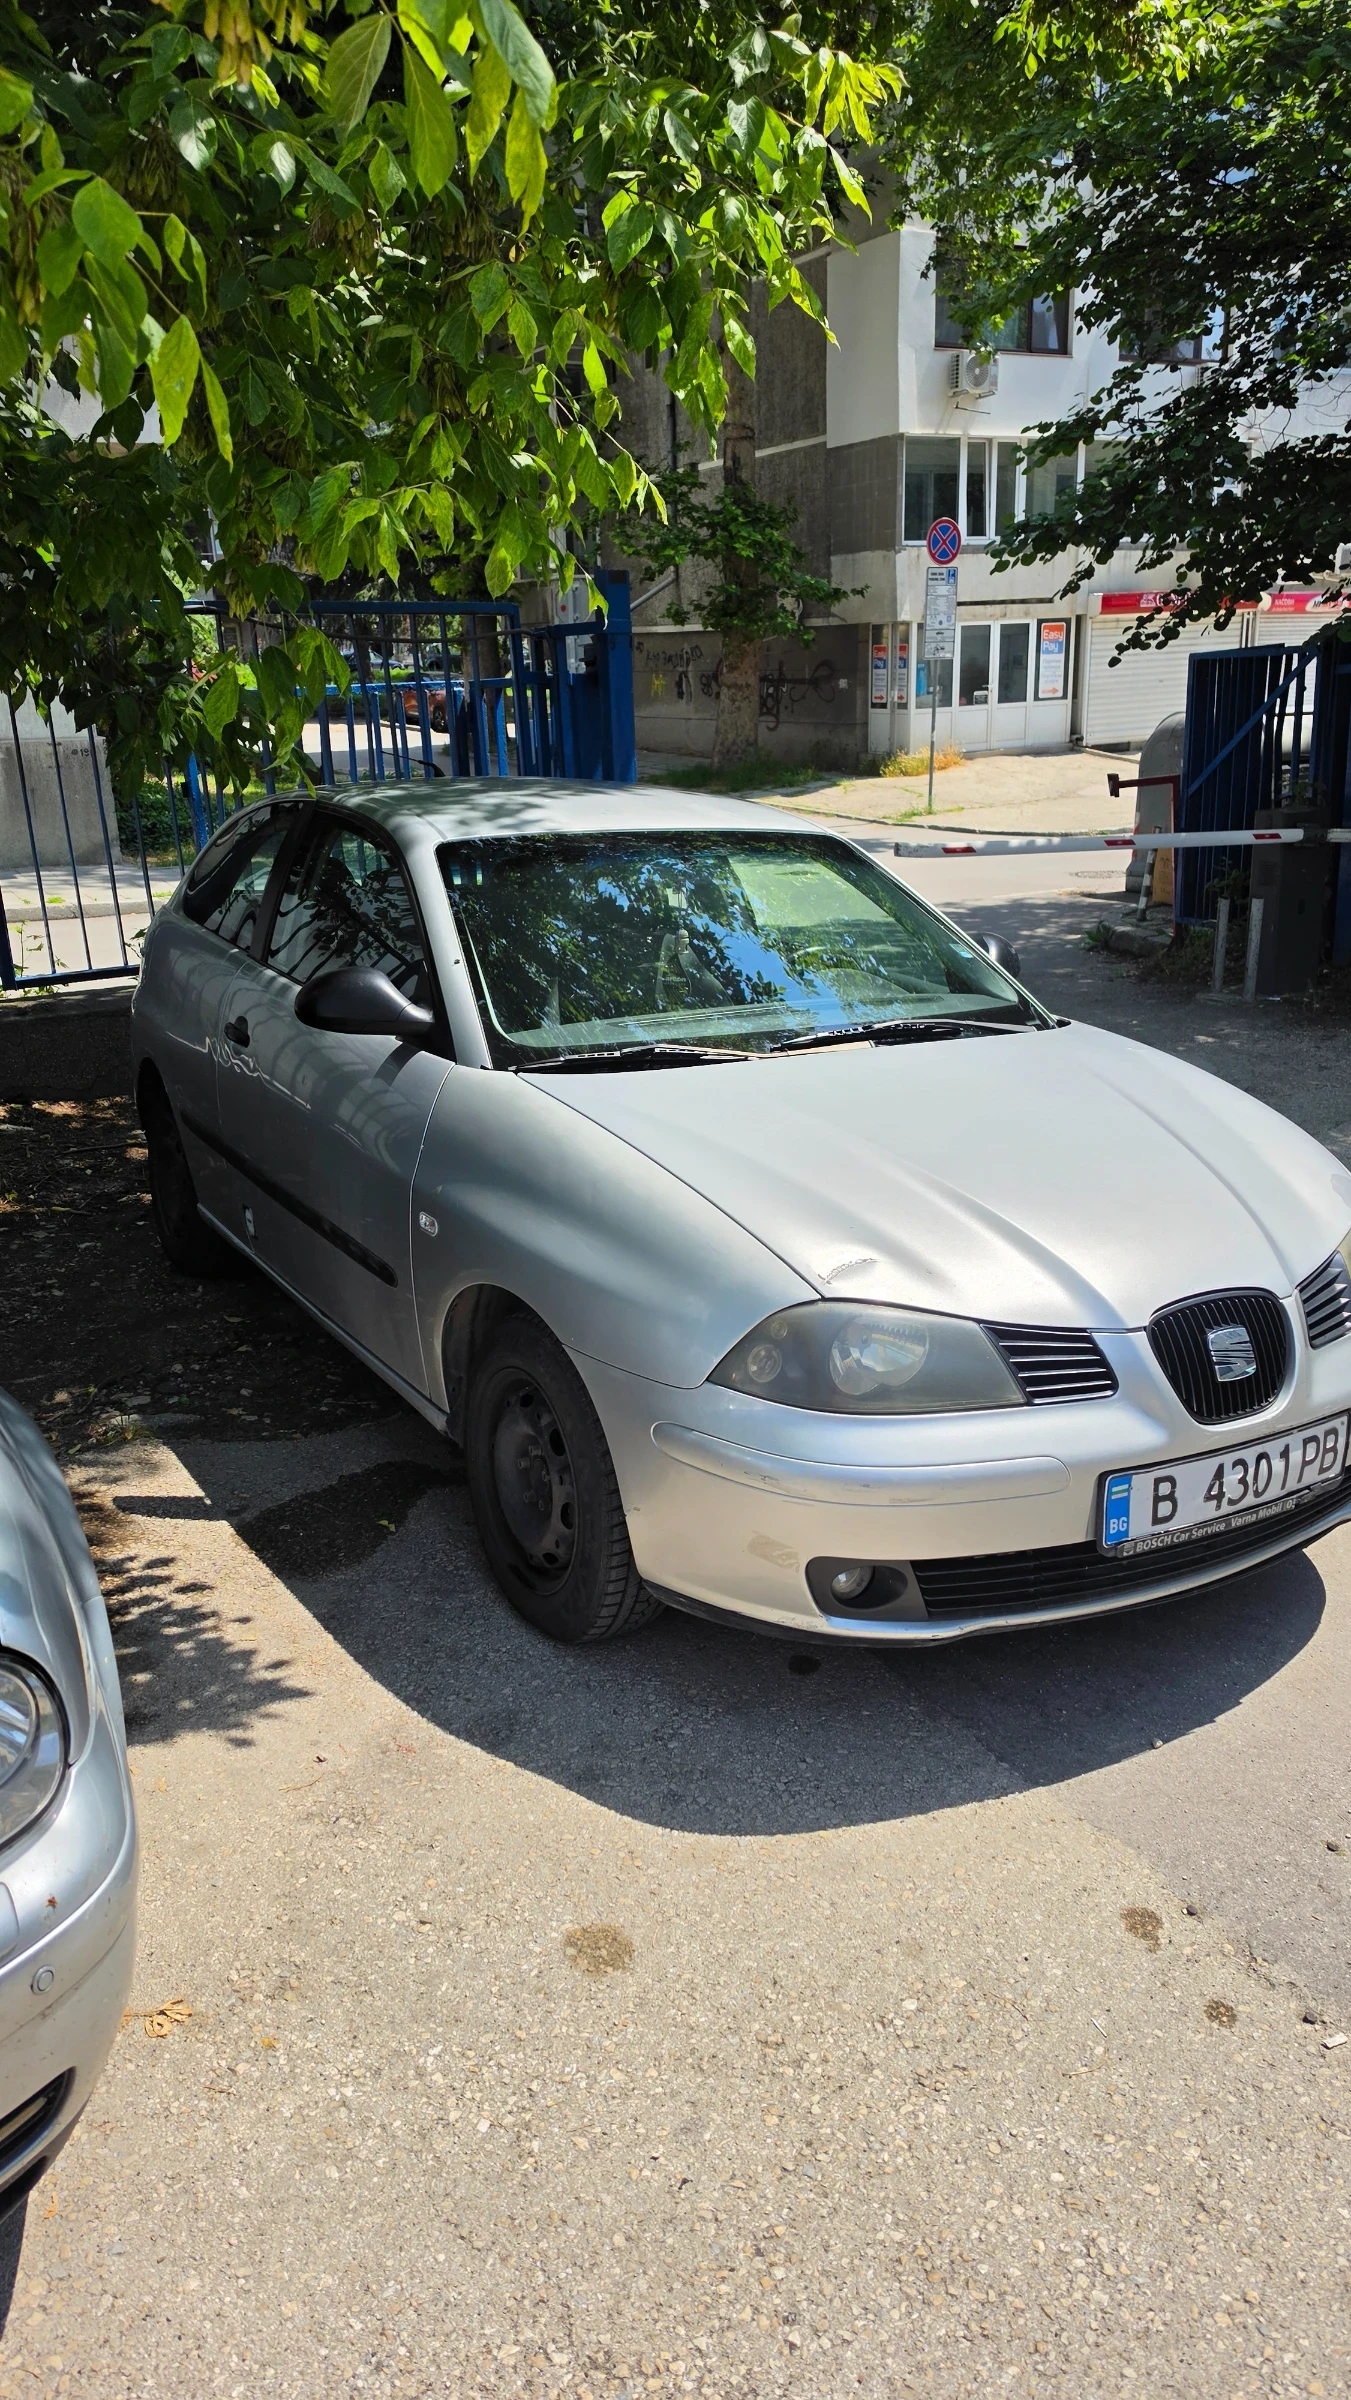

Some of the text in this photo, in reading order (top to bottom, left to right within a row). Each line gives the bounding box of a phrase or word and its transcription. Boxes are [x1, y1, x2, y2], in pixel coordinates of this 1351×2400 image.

[1043, 629, 1063, 641] Easy
[1043, 641, 1059, 652] Pay
[1151, 1475, 1178, 1527] B
[1109, 1517, 1128, 1534] BG
[1136, 1535, 1171, 1553] BOSCH
[1173, 1532, 1189, 1543] Car
[1191, 1522, 1226, 1538] Service
[1231, 1514, 1257, 1527] Varna
[1257, 1502, 1283, 1519] Mobil
